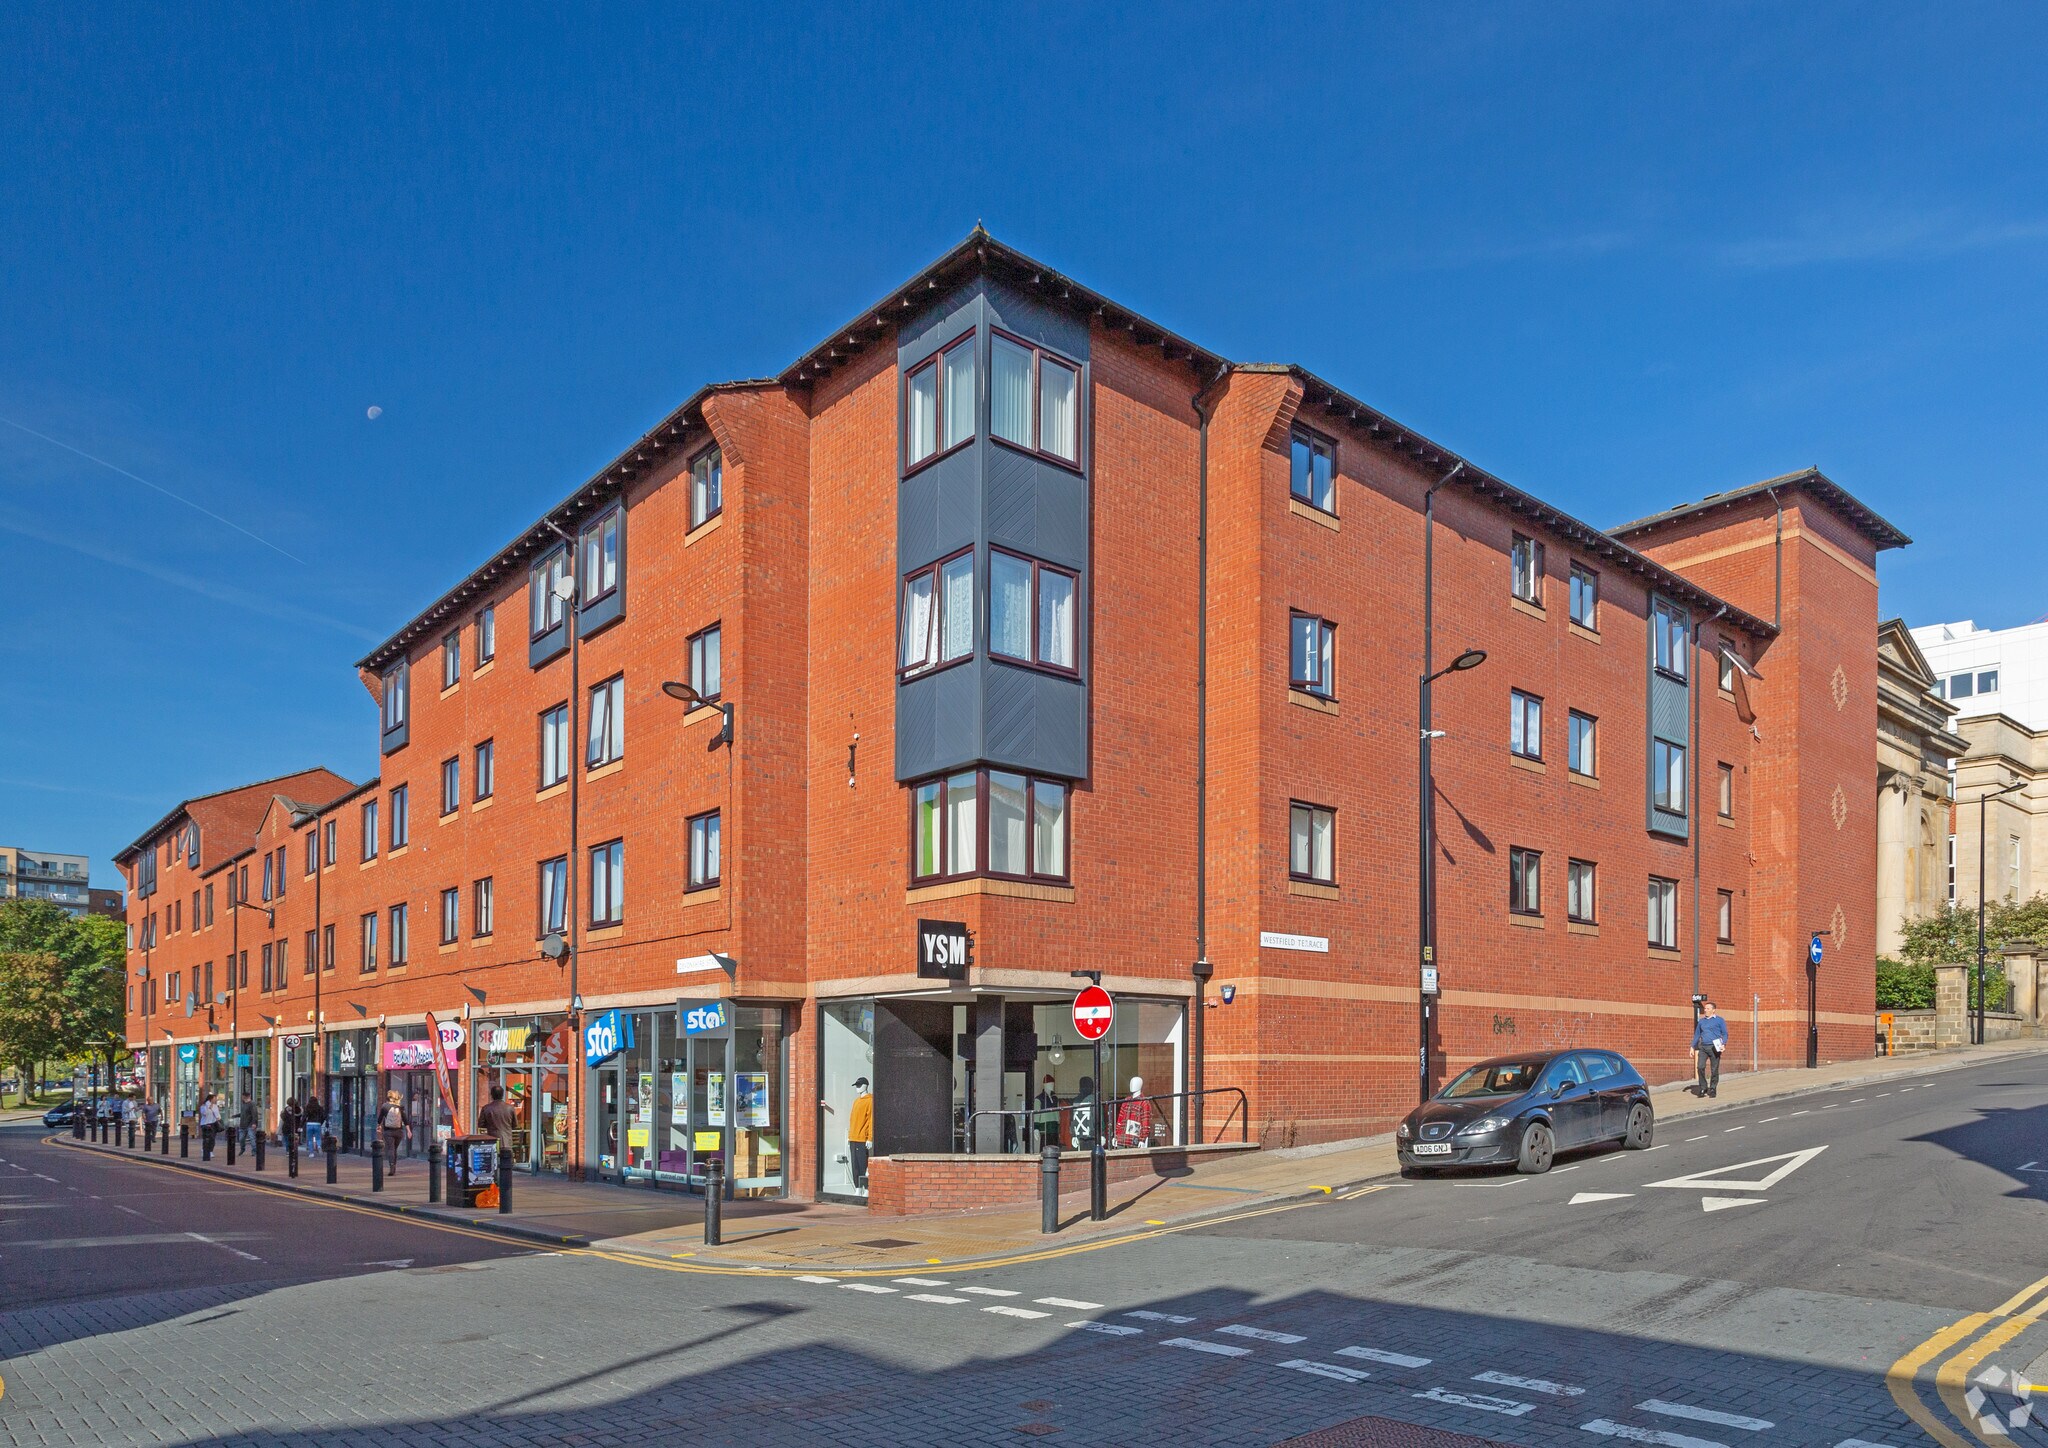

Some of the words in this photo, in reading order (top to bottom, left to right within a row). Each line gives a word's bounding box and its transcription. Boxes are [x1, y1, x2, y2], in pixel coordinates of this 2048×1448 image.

[923, 933, 966, 965] YSM
[1263, 936, 1296, 947] WESTFIELD
[1297, 938, 1324, 949] TERRACE
[687, 1007, 720, 1029] sta
[717, 1002, 727, 1025] TRAVEL
[287, 1037, 299, 1045] 20
[439, 1029, 460, 1043] BR
[489, 1025, 531, 1051] SUBWAY
[586, 1020, 613, 1057] sta
[609, 1010, 618, 1049] TRAVEL
